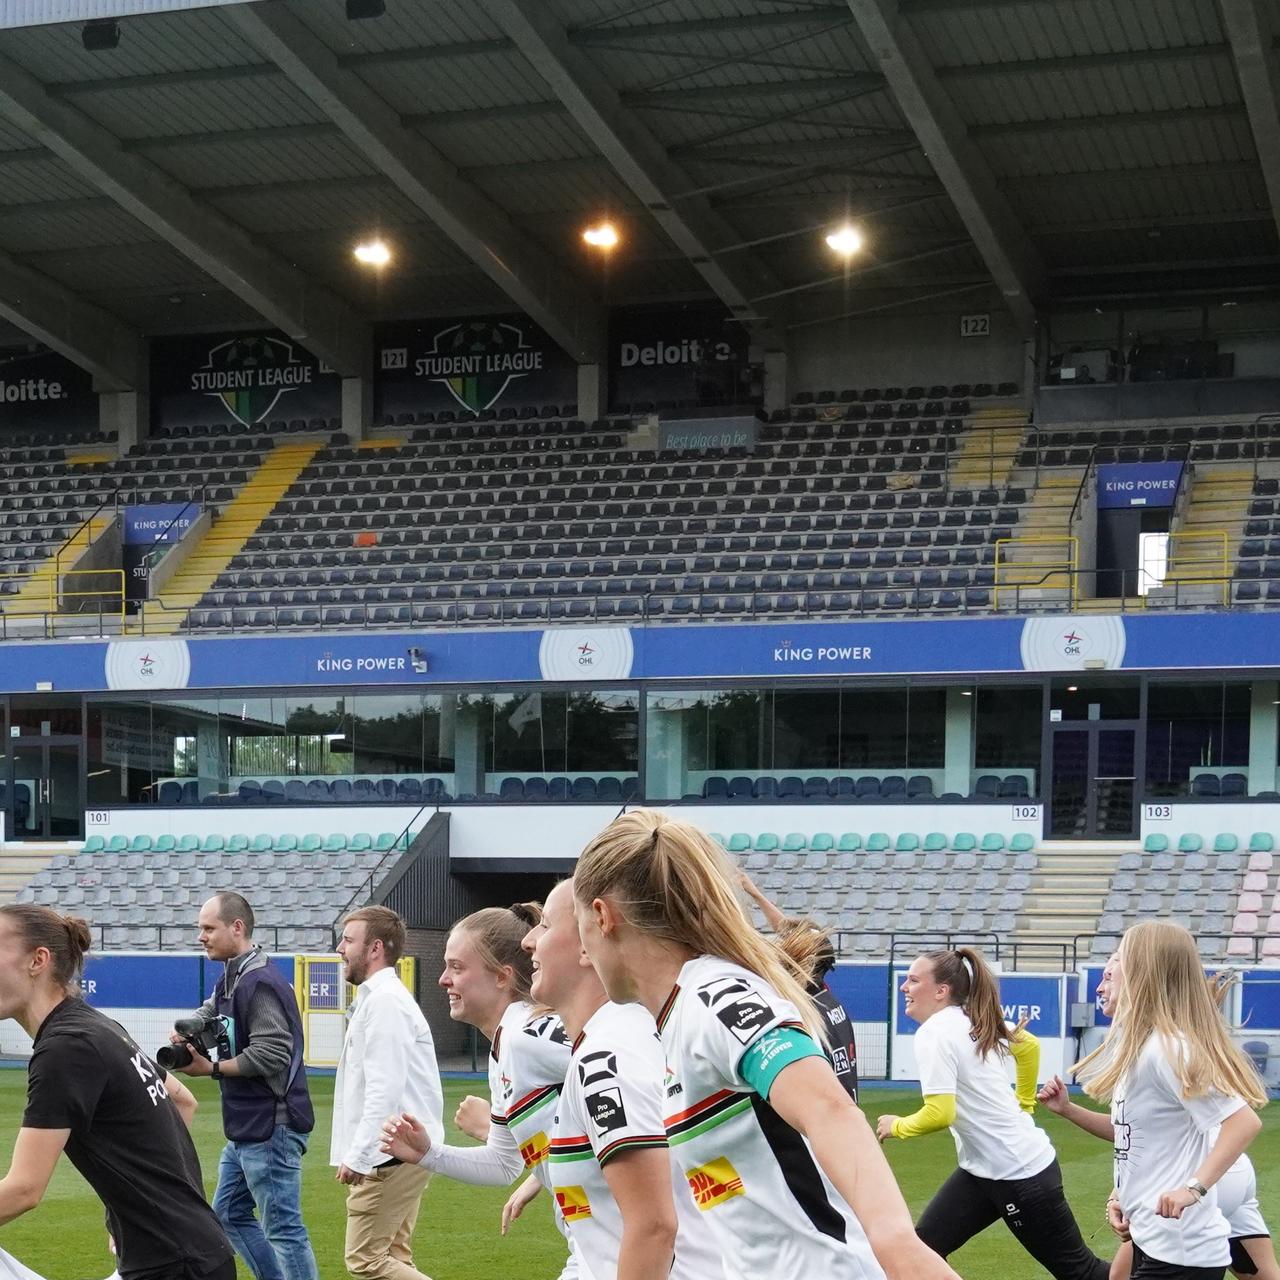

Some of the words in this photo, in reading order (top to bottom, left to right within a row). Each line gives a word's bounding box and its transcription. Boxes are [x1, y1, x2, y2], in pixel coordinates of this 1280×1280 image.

[962, 318, 987, 333] 122
[382, 351, 405, 367] 121
[415, 355, 481, 376] STUDENT
[487, 352, 542, 372] LEAGUE
[191, 369, 254, 391] STUDENT
[258, 366, 311, 386] LEAGUE
[666, 433, 687, 448] Best
[1106, 481, 1134, 491] KING
[1136, 480, 1176, 490] POWER
[134, 521, 156, 530] KING
[159, 519, 190, 528] POWER
[774, 648, 813, 661] KING
[818, 647, 871, 660] POWER
[1064, 646, 1080, 654] OHL
[317, 658, 352, 672] KING
[357, 657, 405, 670] POWER
[578, 656, 593, 665] OHL
[90, 812, 108, 823] 101
[1015, 808, 1037, 818] 102
[1148, 807, 1170, 817] 103
[736, 1008, 764, 1027] League
[738, 1007, 753, 1018] Pro
[769, 1041, 793, 1061] LEUVEN
[597, 1103, 608, 1112] Pro
[595, 1108, 616, 1122] League
